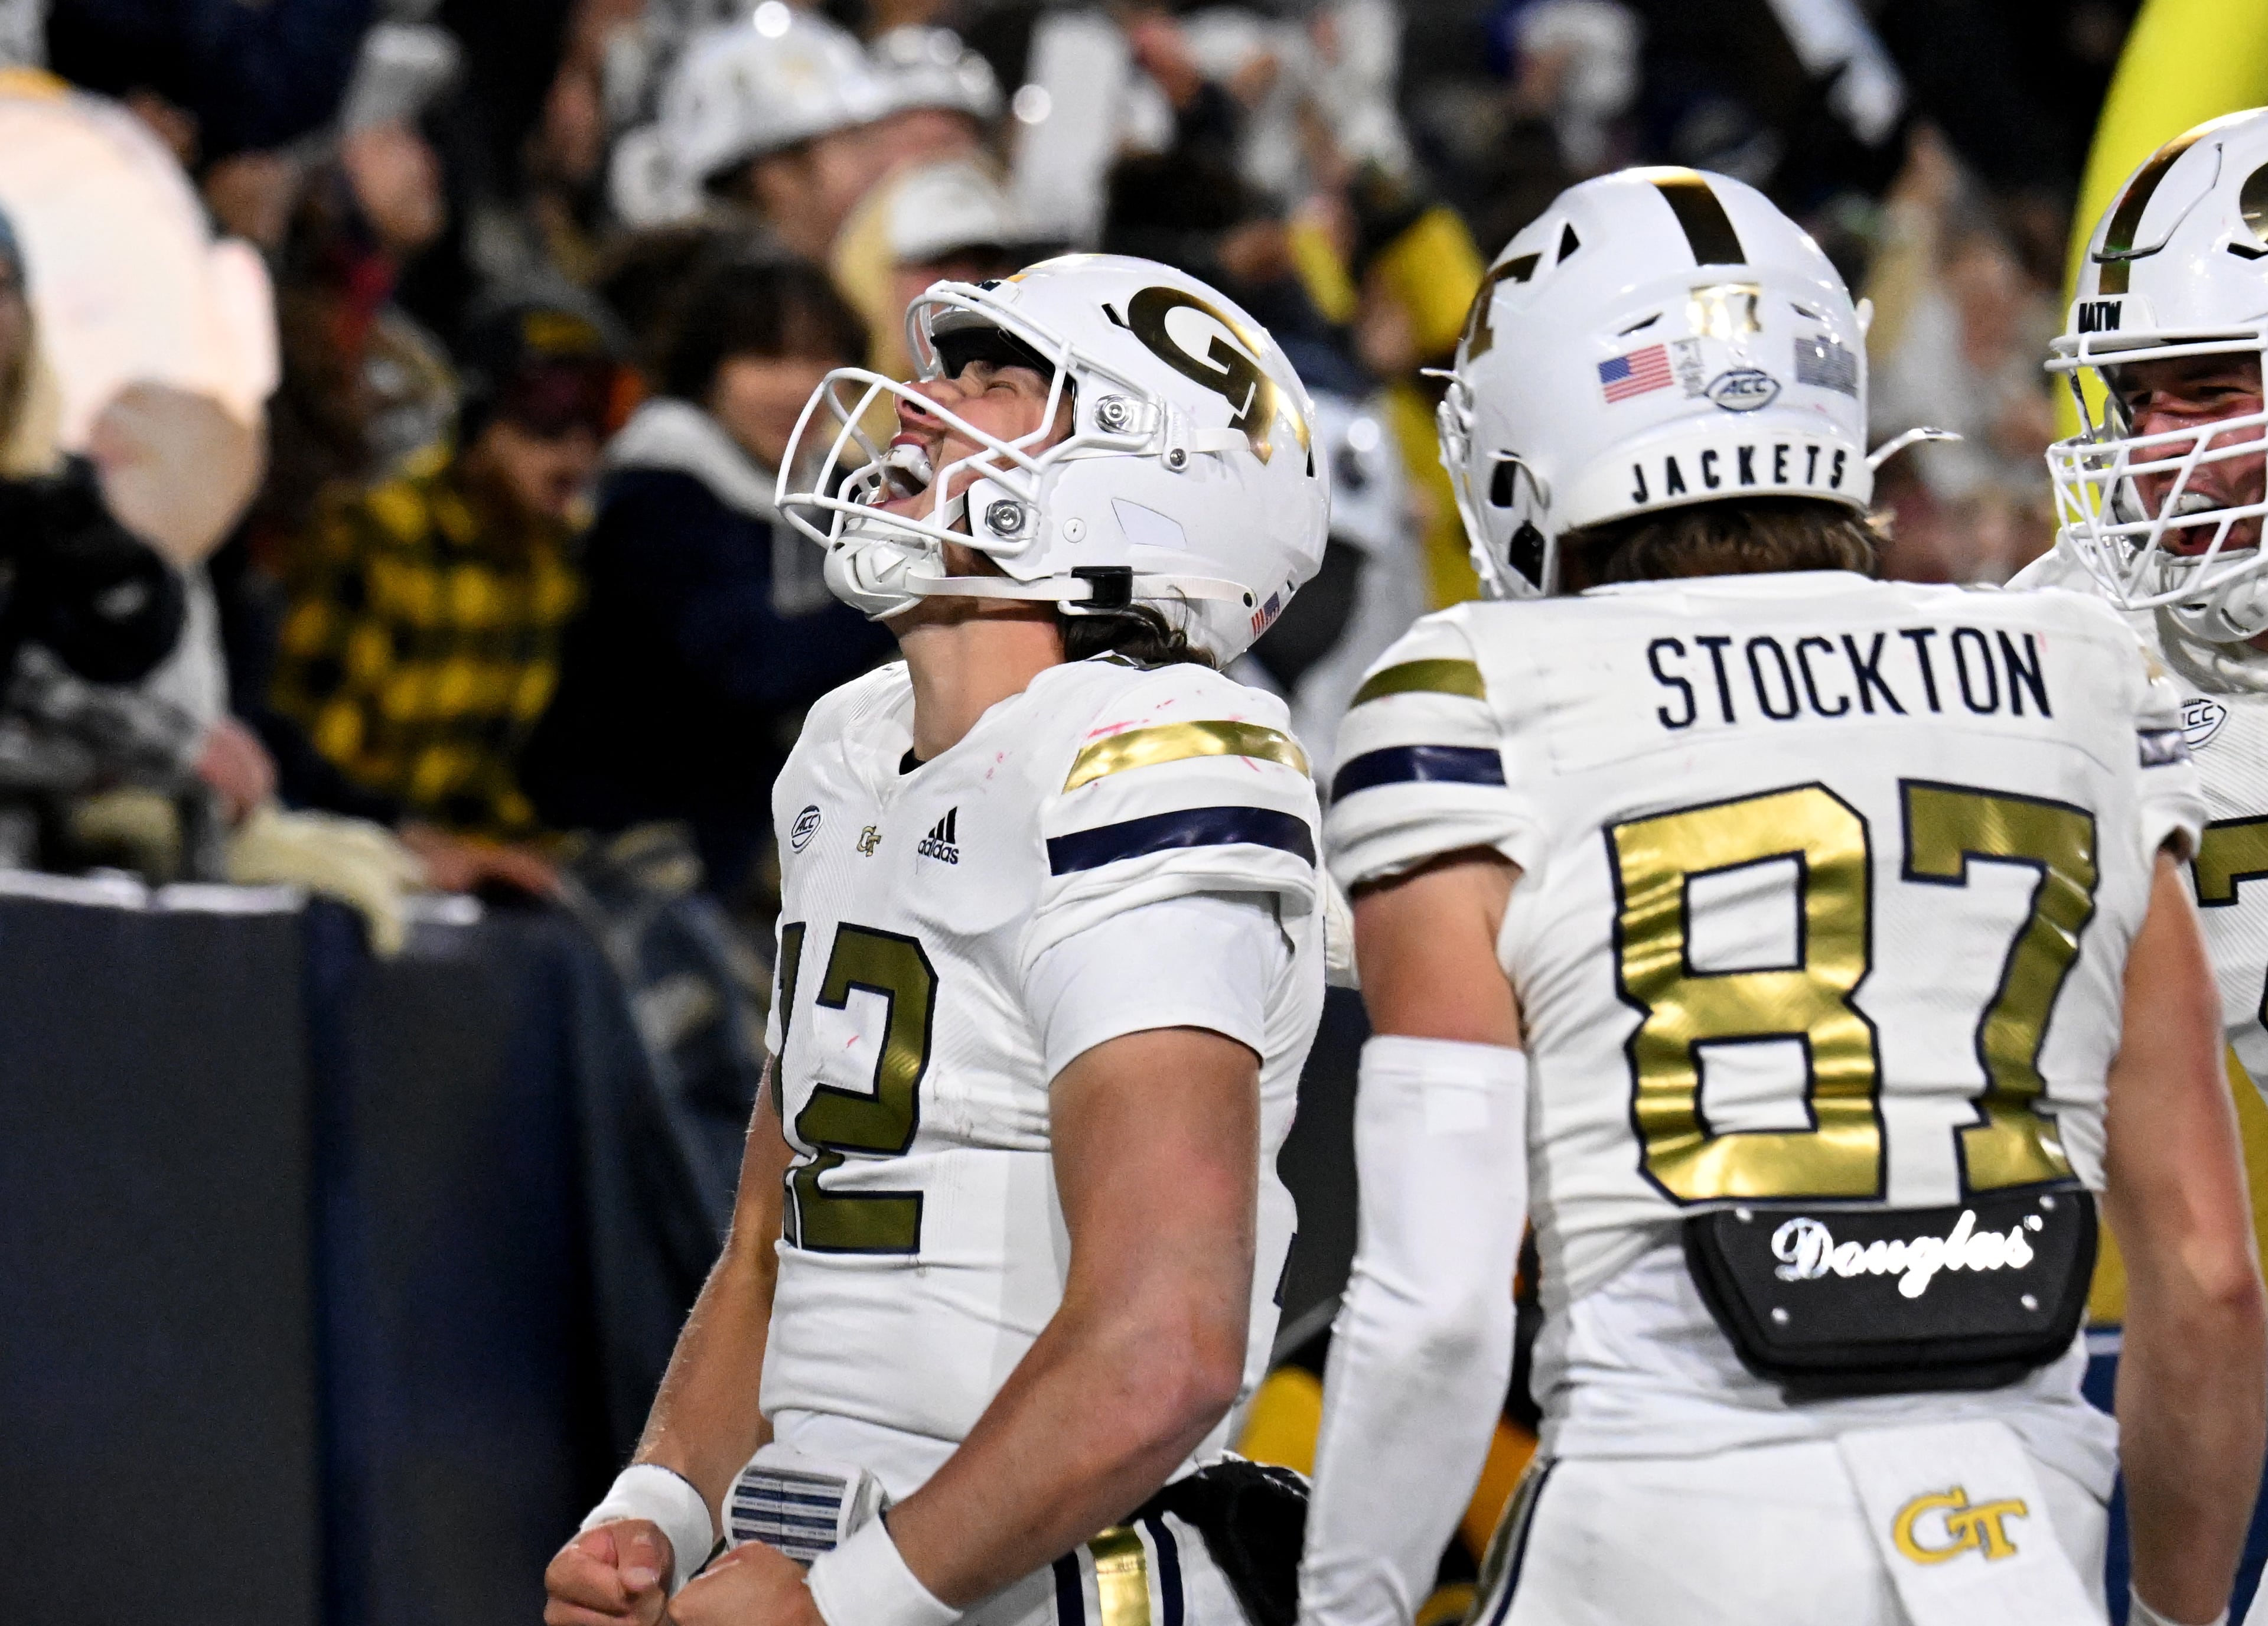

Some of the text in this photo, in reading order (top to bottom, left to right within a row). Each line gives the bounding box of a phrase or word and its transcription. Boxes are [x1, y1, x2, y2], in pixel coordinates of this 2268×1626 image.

[1718, 377, 1769, 395] ACC
[1631, 444, 1846, 504] JACKETS
[1648, 627, 2052, 729] STOCKTON
[2182, 705, 2215, 726] CC
[794, 814, 820, 833] ACC
[918, 838, 960, 865] adidas
[1604, 777, 2100, 1207] 87
[1772, 1210, 2033, 1298] Douglas
[1891, 1485, 2029, 1565] GT
